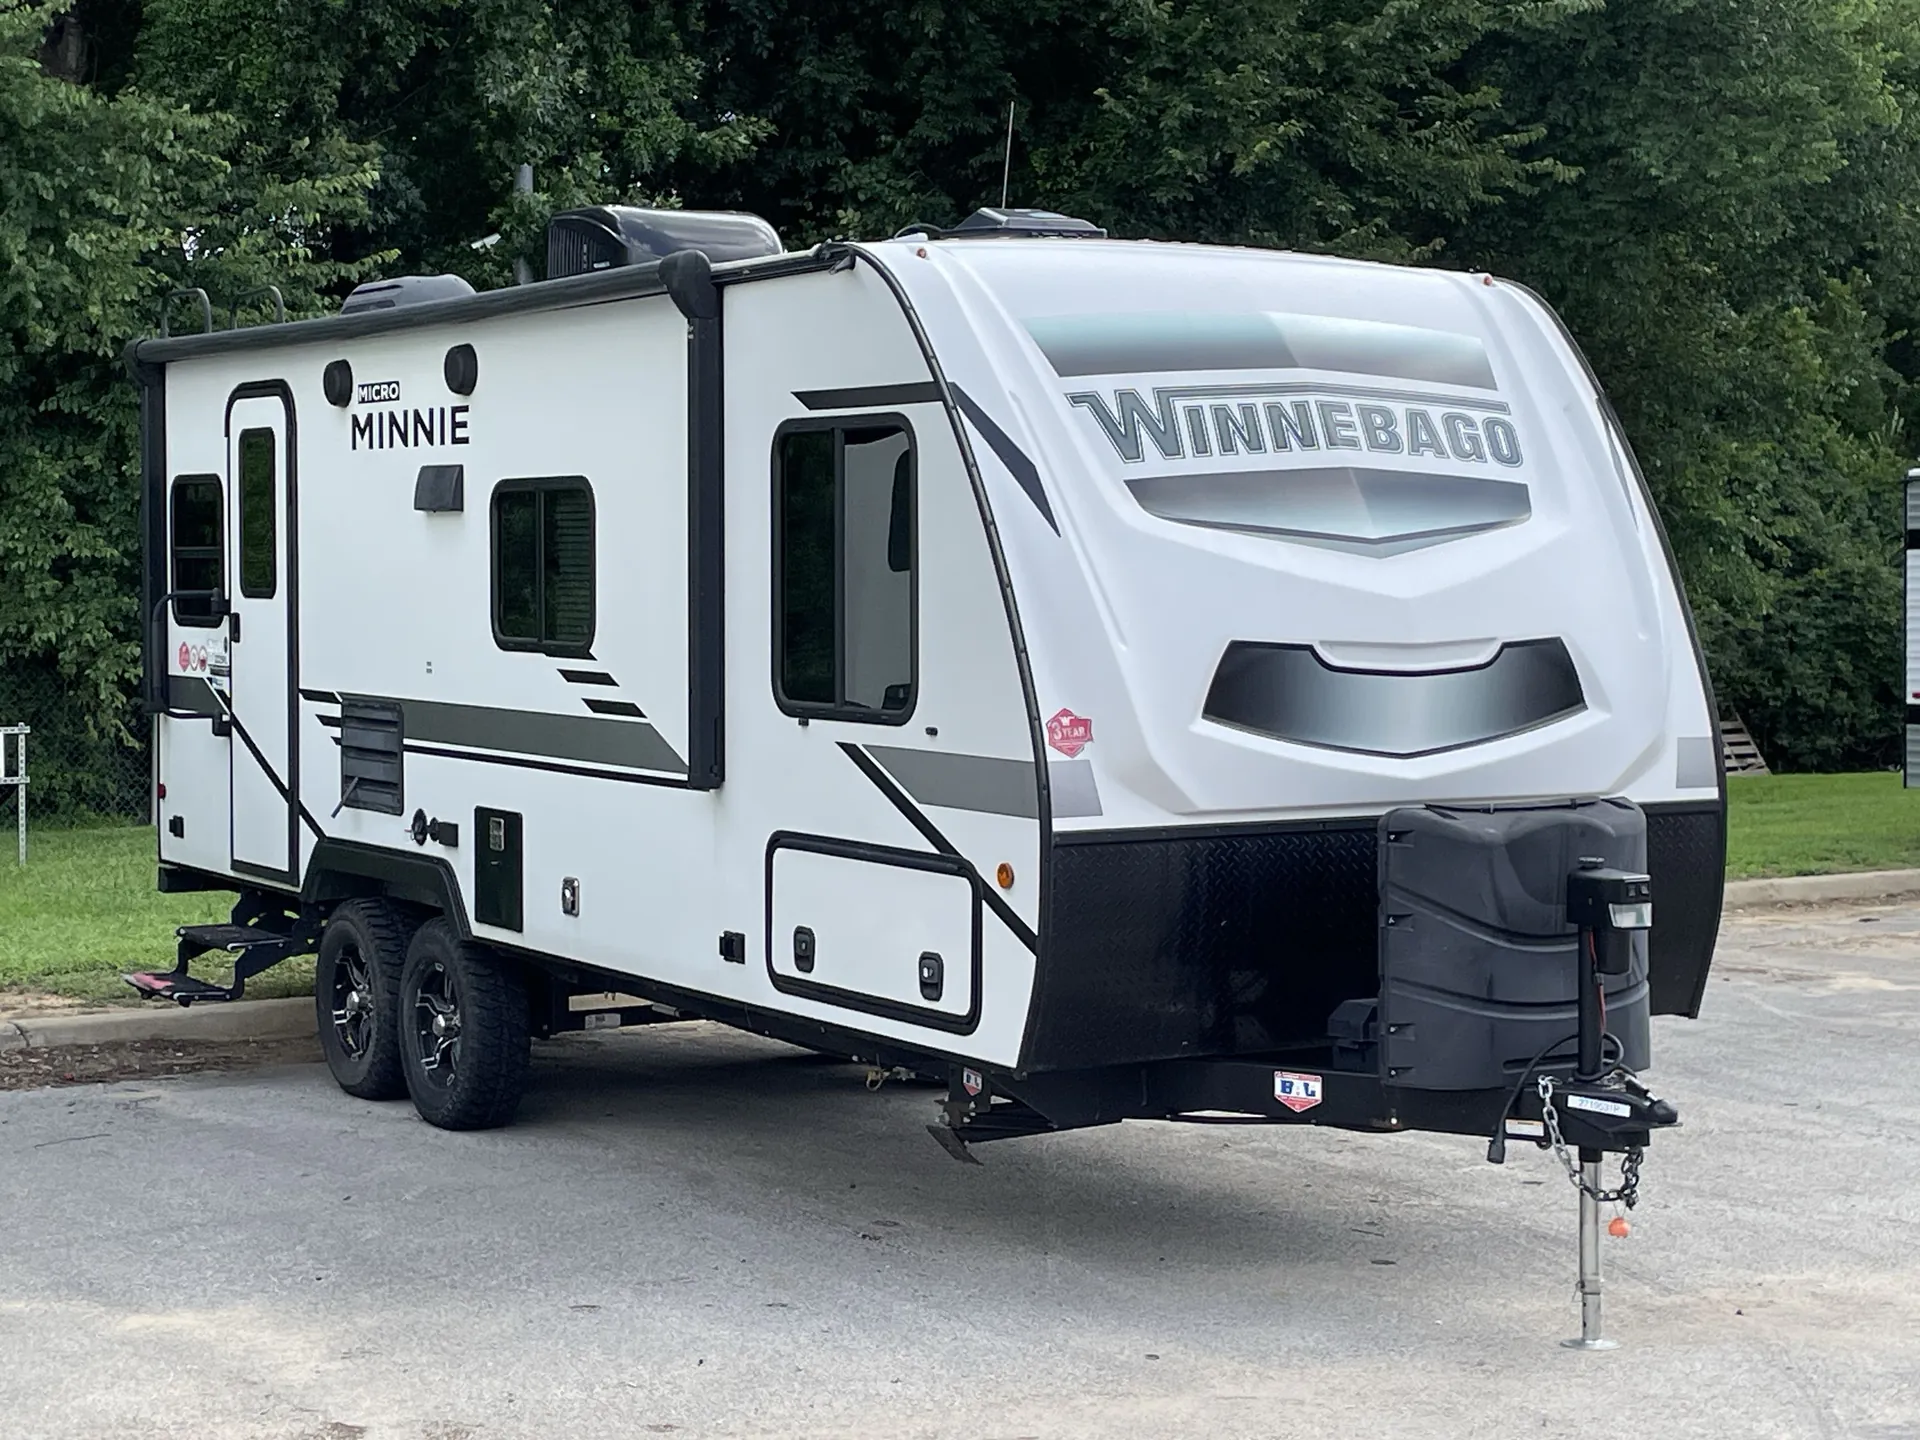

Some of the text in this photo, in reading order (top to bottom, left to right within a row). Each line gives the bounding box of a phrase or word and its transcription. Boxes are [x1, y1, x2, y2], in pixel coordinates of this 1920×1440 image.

[359, 382, 399, 402] MICRO
[351, 405, 470, 451] MINNIE
[1064, 382, 1523, 467] WINNEBAGO
[1051, 721, 1086, 740] 3 YEAR
